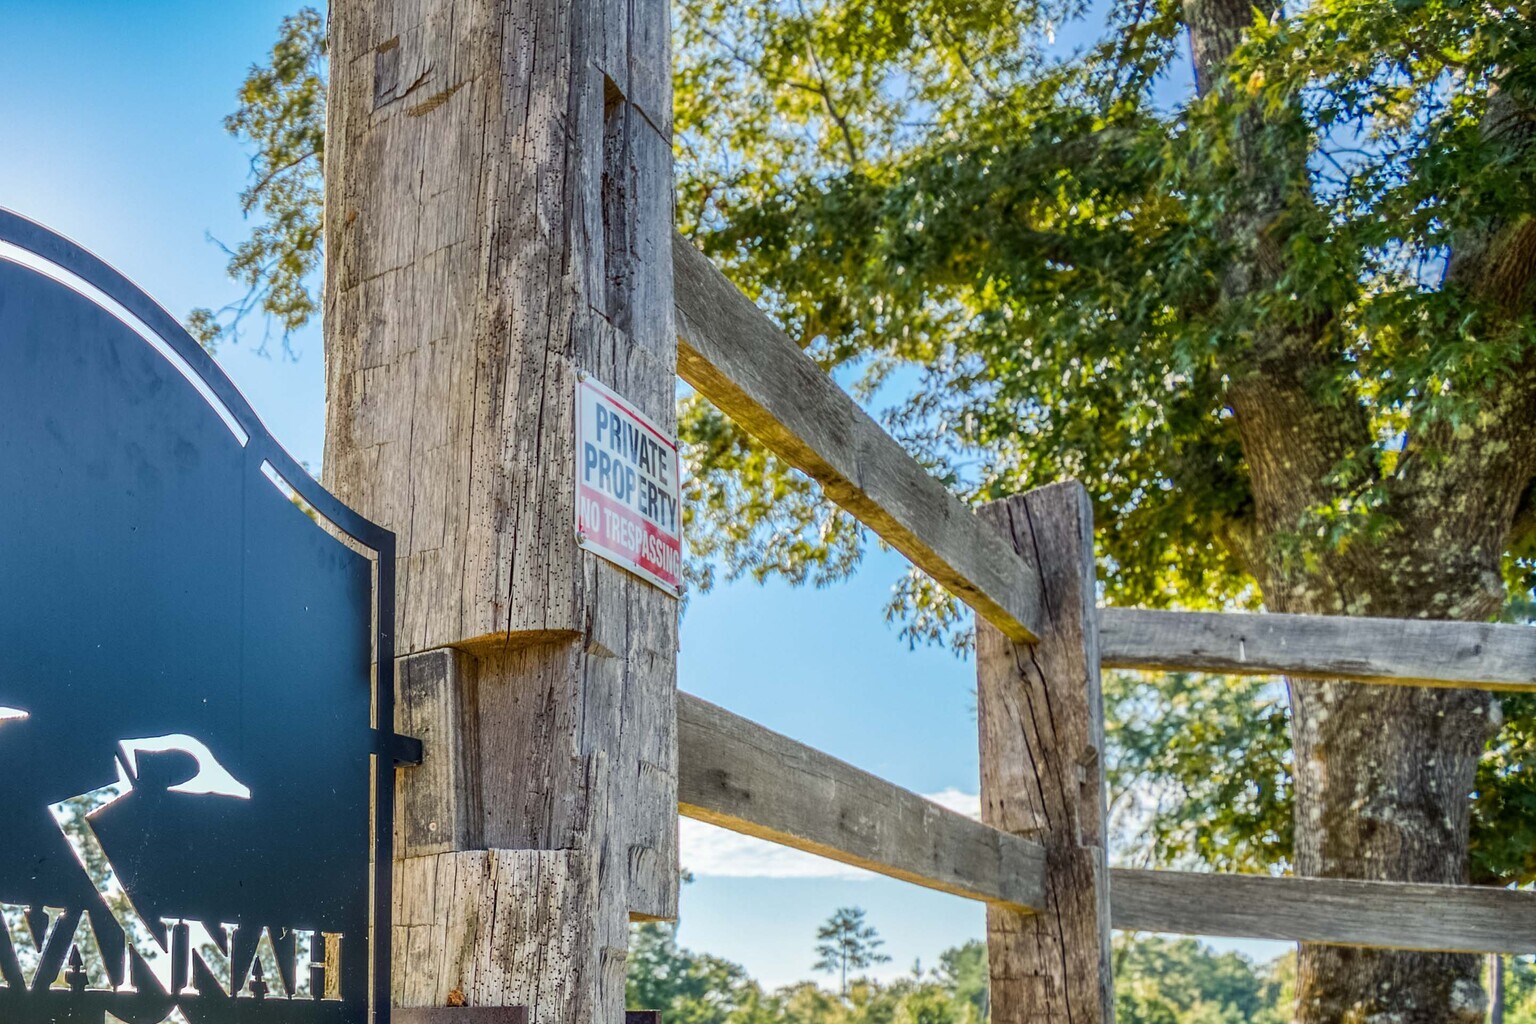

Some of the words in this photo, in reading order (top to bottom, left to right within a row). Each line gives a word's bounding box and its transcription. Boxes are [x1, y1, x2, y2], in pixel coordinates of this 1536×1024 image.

[596, 403, 667, 486] PRIVATE
[584, 442, 677, 532] PROPERTY
[580, 496, 601, 534] NO
[605, 510, 679, 578] TRESPASSING
